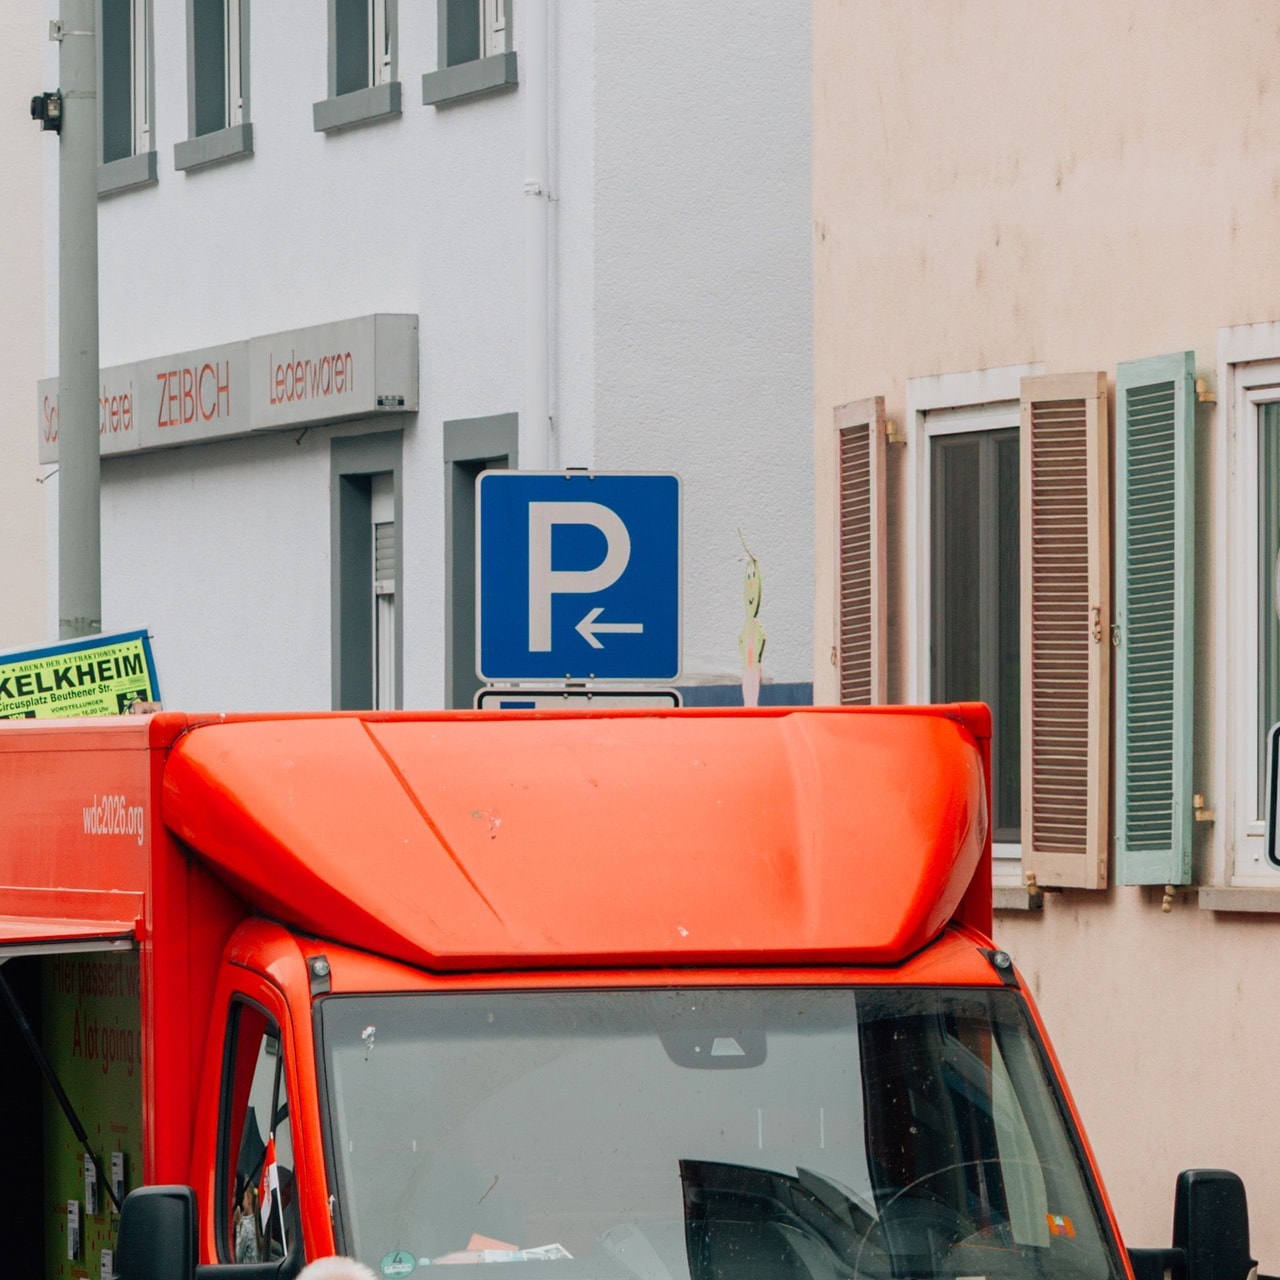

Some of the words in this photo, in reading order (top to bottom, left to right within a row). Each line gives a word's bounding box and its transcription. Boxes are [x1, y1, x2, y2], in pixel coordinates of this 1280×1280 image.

[157, 361, 230, 428] ZEIBICH
[270, 350, 353, 404] Lederwaren
[529, 501, 631, 652] P
[19, 663, 44, 673] ARENA
[46, 659, 60, 668] DER
[62, 649, 116, 665] ATTRAKTIONEN
[50, 686, 96, 703] Beuthener
[99, 683, 113, 693] Str.
[51, 699, 104, 713] VORSTELLUNGEN
[83, 795, 144, 846] wdc2026.org
[78, 952, 124, 1007] passiert
[72, 1009, 82, 1058] A
[84, 1009, 99, 1059] lot
[102, 1015, 134, 1077] going
[392, 1252, 402, 1264] 4
